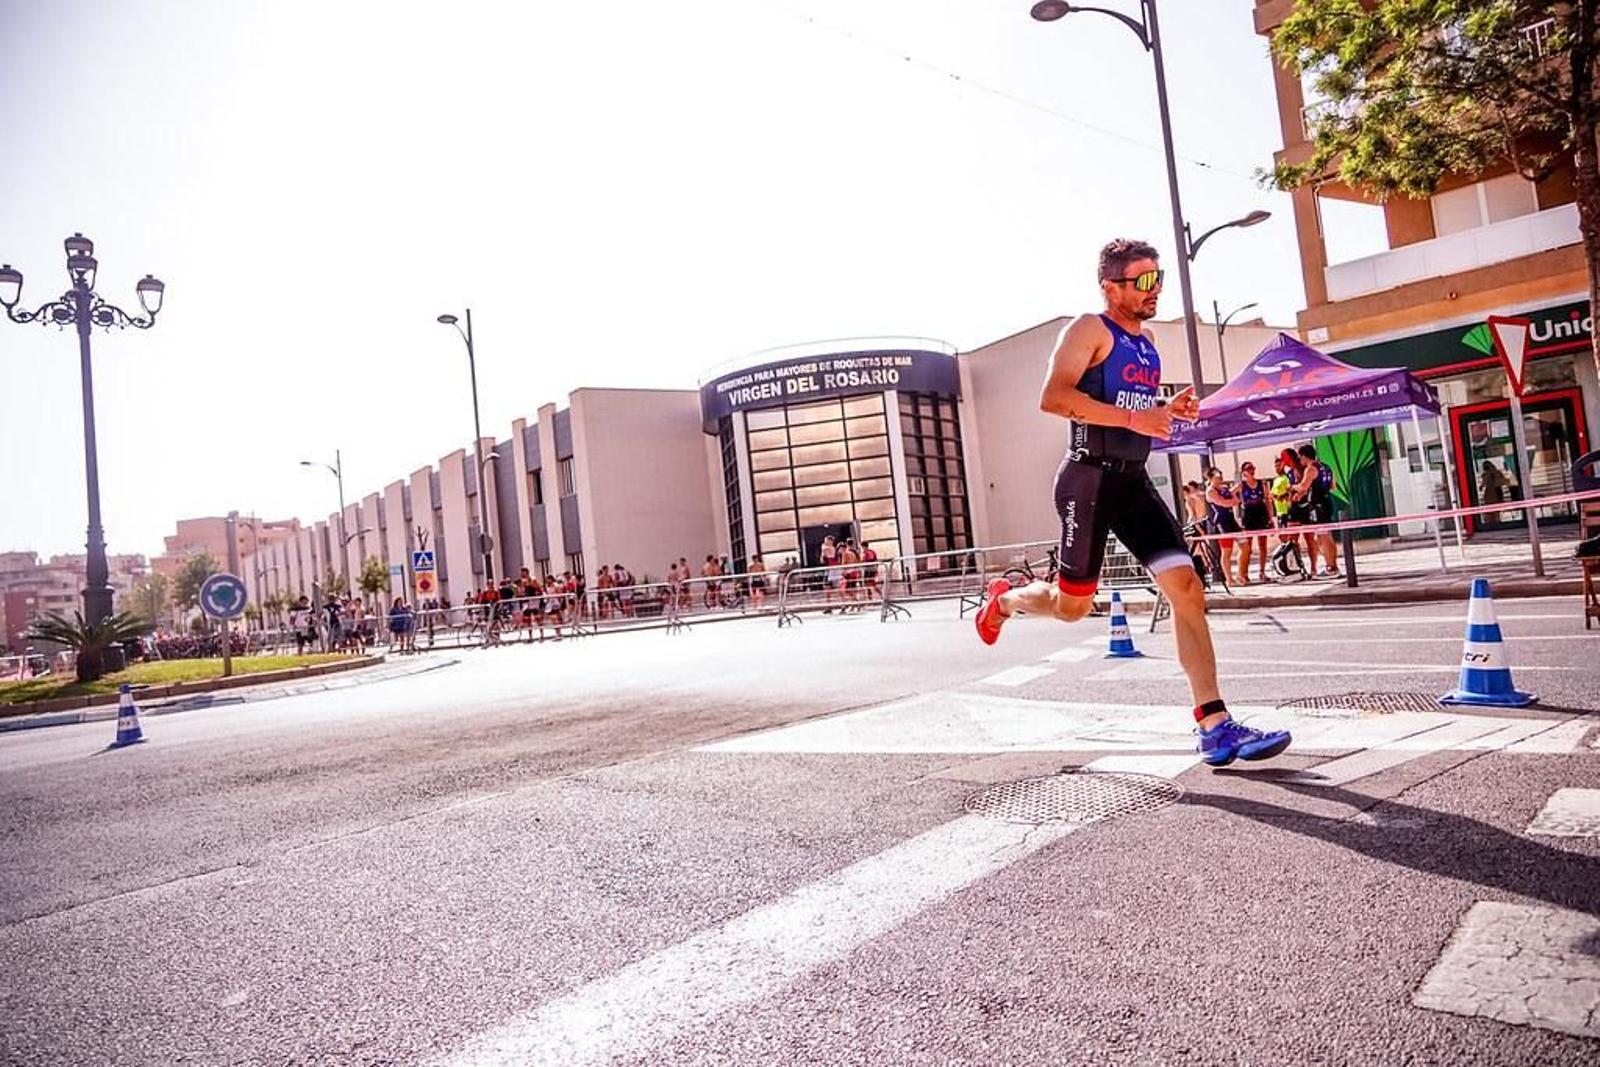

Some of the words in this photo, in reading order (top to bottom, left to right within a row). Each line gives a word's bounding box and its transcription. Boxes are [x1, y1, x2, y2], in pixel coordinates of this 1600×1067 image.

[728, 380, 782, 406] VIRGEN
[786, 376, 820, 395] DEL
[823, 368, 900, 390] ROSARIO
[754, 369, 775, 382] PARA
[776, 362, 818, 377] MAYORES
[819, 361, 832, 371] DE
[833, 356, 881, 371] ROQUETAS
[882, 356, 894, 366] DE
[894, 356, 913, 366] MAR
[1064, 500, 1079, 548] syngenta
